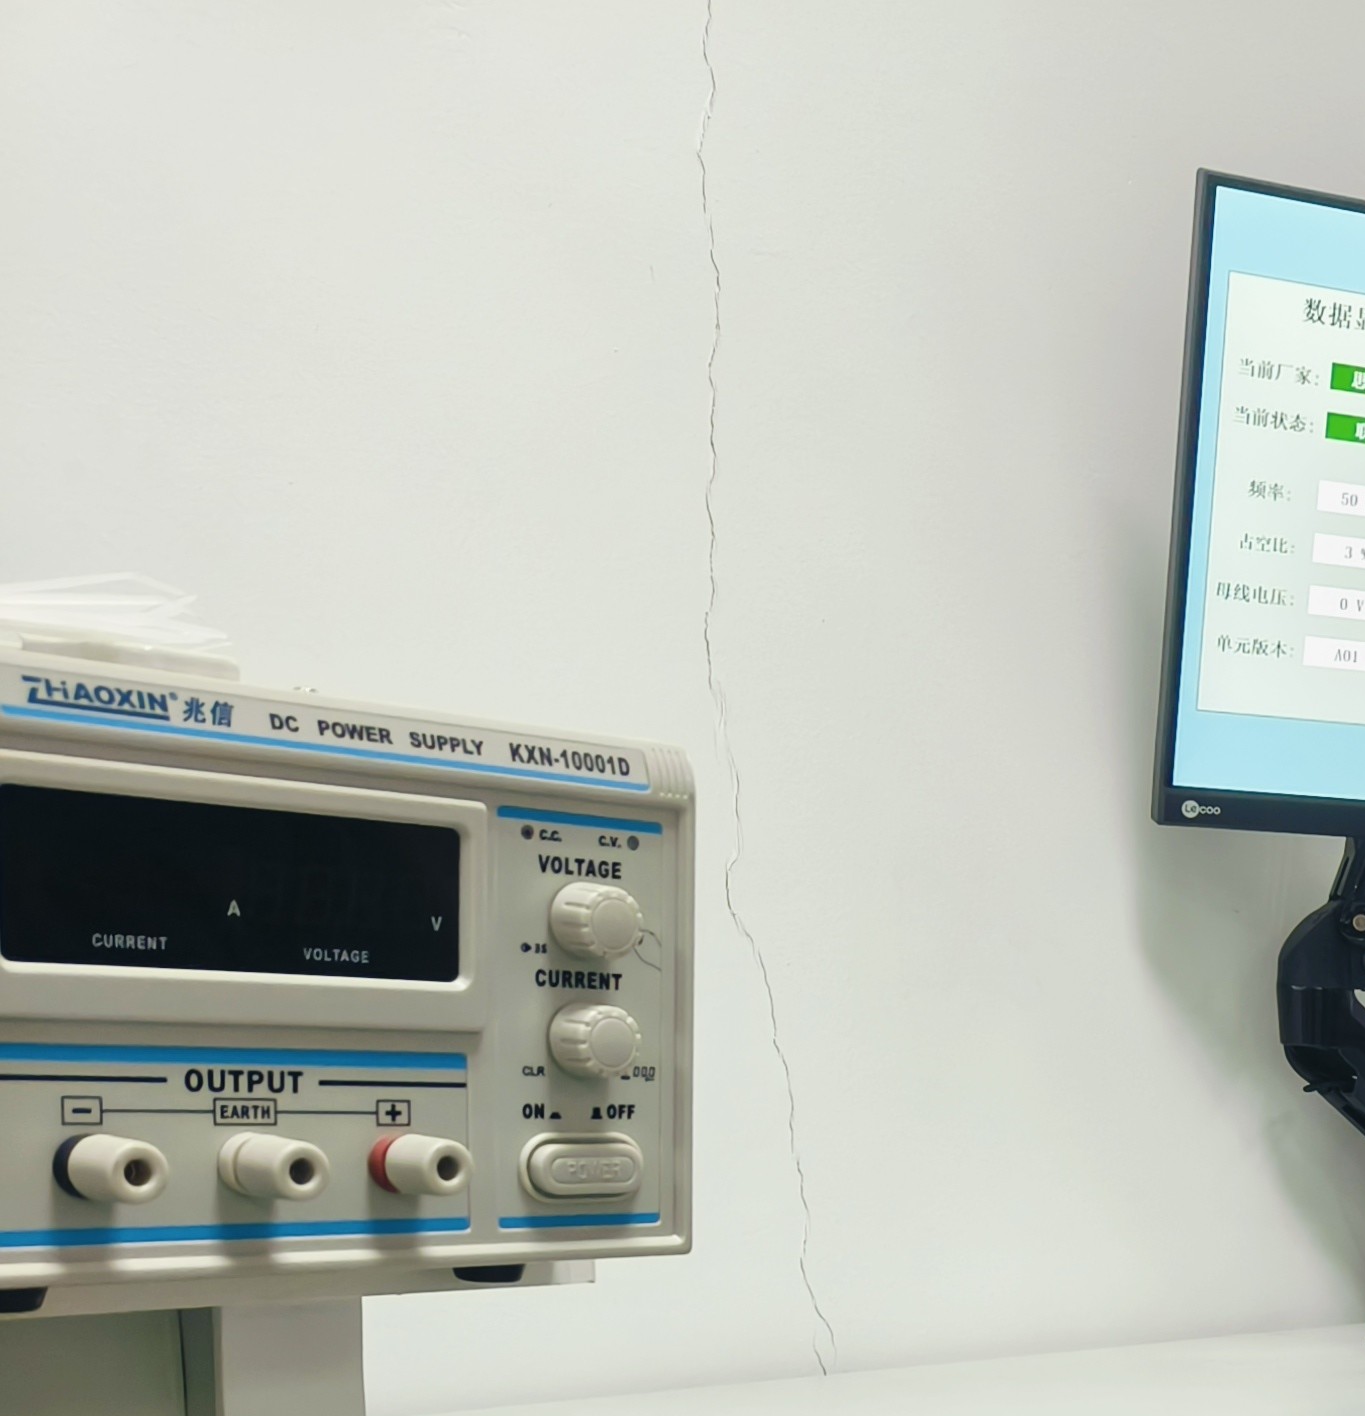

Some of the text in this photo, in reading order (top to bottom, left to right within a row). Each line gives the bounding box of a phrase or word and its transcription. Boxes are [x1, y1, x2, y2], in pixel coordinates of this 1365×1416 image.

[1340, 492, 1359, 508] 50
[1344, 545, 1353, 560] 3
[1339, 596, 1364, 613] 0 V
[183, 697, 234, 728] 兆信
[269, 713, 630, 776] DC POWER SUPPLY KXN-10001D
[538, 854, 622, 879] VOLTAGE
[227, 900, 241, 917] A
[431, 916, 442, 931] V
[92, 933, 168, 951] CURRENT
[303, 947, 370, 964] VOLTAGE
[535, 969, 622, 991] CURRENT
[184, 1069, 304, 1094] OUTPUT
[219, 1105, 271, 1120] EARTH
[522, 1103, 545, 1119] ON
[607, 1104, 635, 1120] OFF
